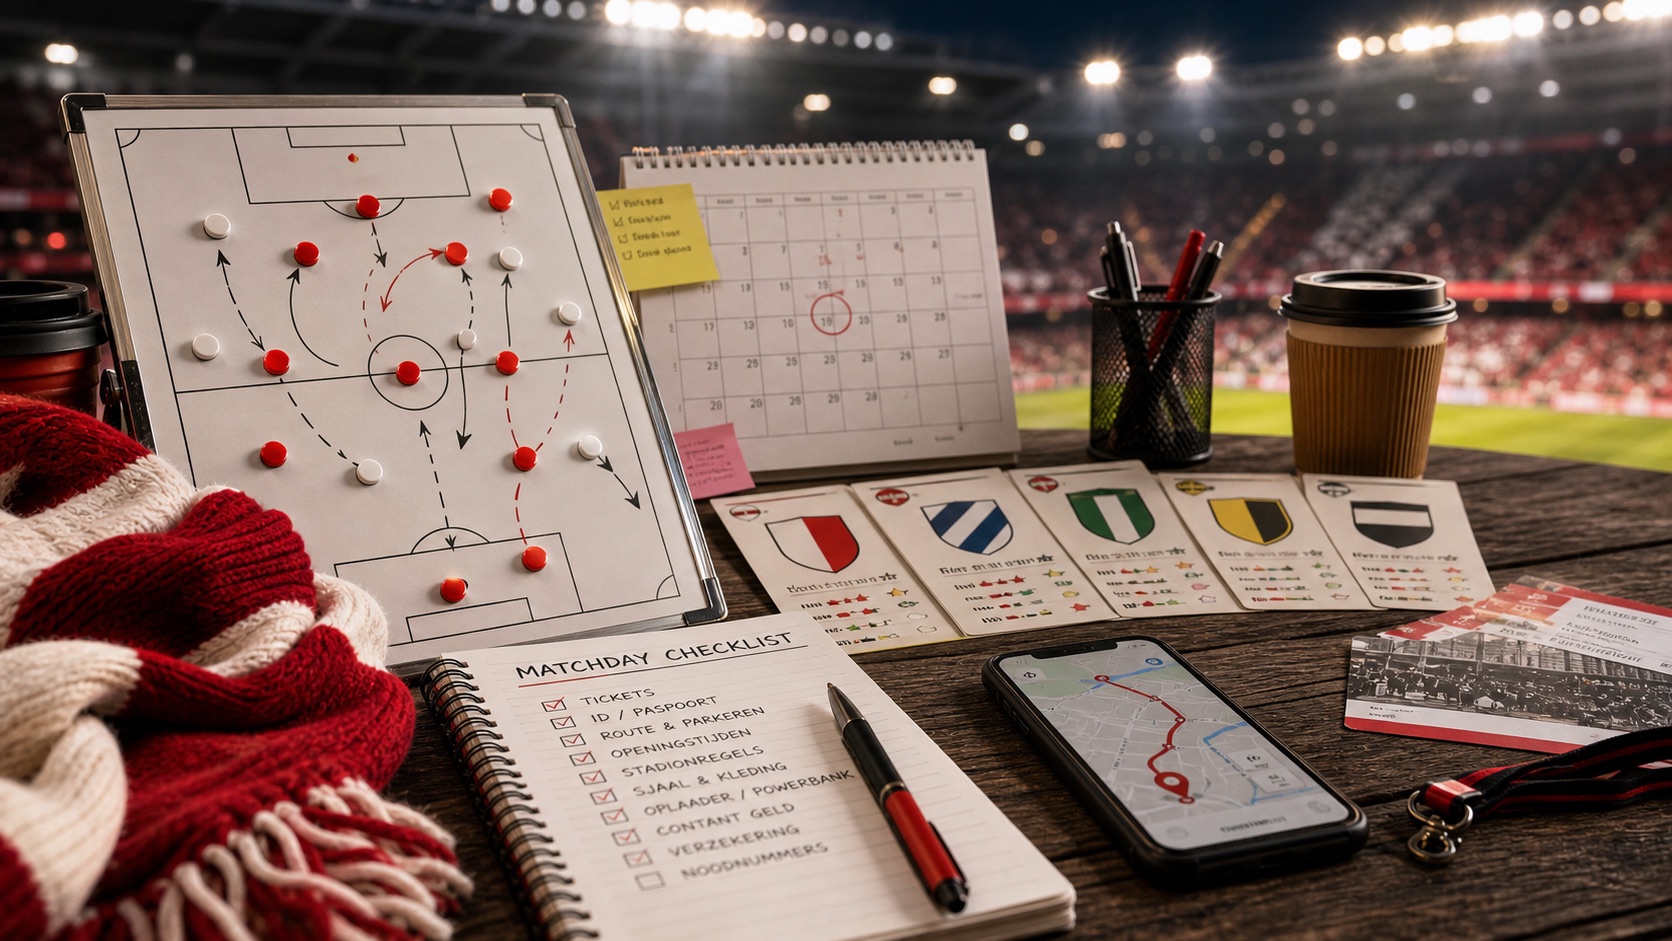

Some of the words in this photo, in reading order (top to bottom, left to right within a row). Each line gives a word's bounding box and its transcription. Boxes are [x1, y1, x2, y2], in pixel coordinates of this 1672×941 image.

[515, 652, 650, 680] MATCHDAY
[665, 631, 793, 662] CHECKLIST
[580, 688, 655, 706] TICKETS
[591, 712, 609, 723] ID
[633, 696, 718, 717] PASPOORT
[600, 725, 656, 741] ROUTE
[664, 722, 675, 730] &
[683, 706, 765, 728] PARKEREN
[611, 727, 752, 759] OPENINGSTIJDEN
[622, 745, 765, 778] STADIONREGELS
[633, 779, 691, 797] SJAAL
[697, 775, 710, 785] &
[716, 761, 787, 782] KLEDING
[644, 791, 735, 817] OPLAADER
[752, 769, 855, 797] POWERBANK
[656, 812, 741, 836] CONTANT
[750, 802, 795, 820] GELD
[668, 824, 801, 857] VERZEKERING
[681, 842, 829, 880] NOODNUMMERS
